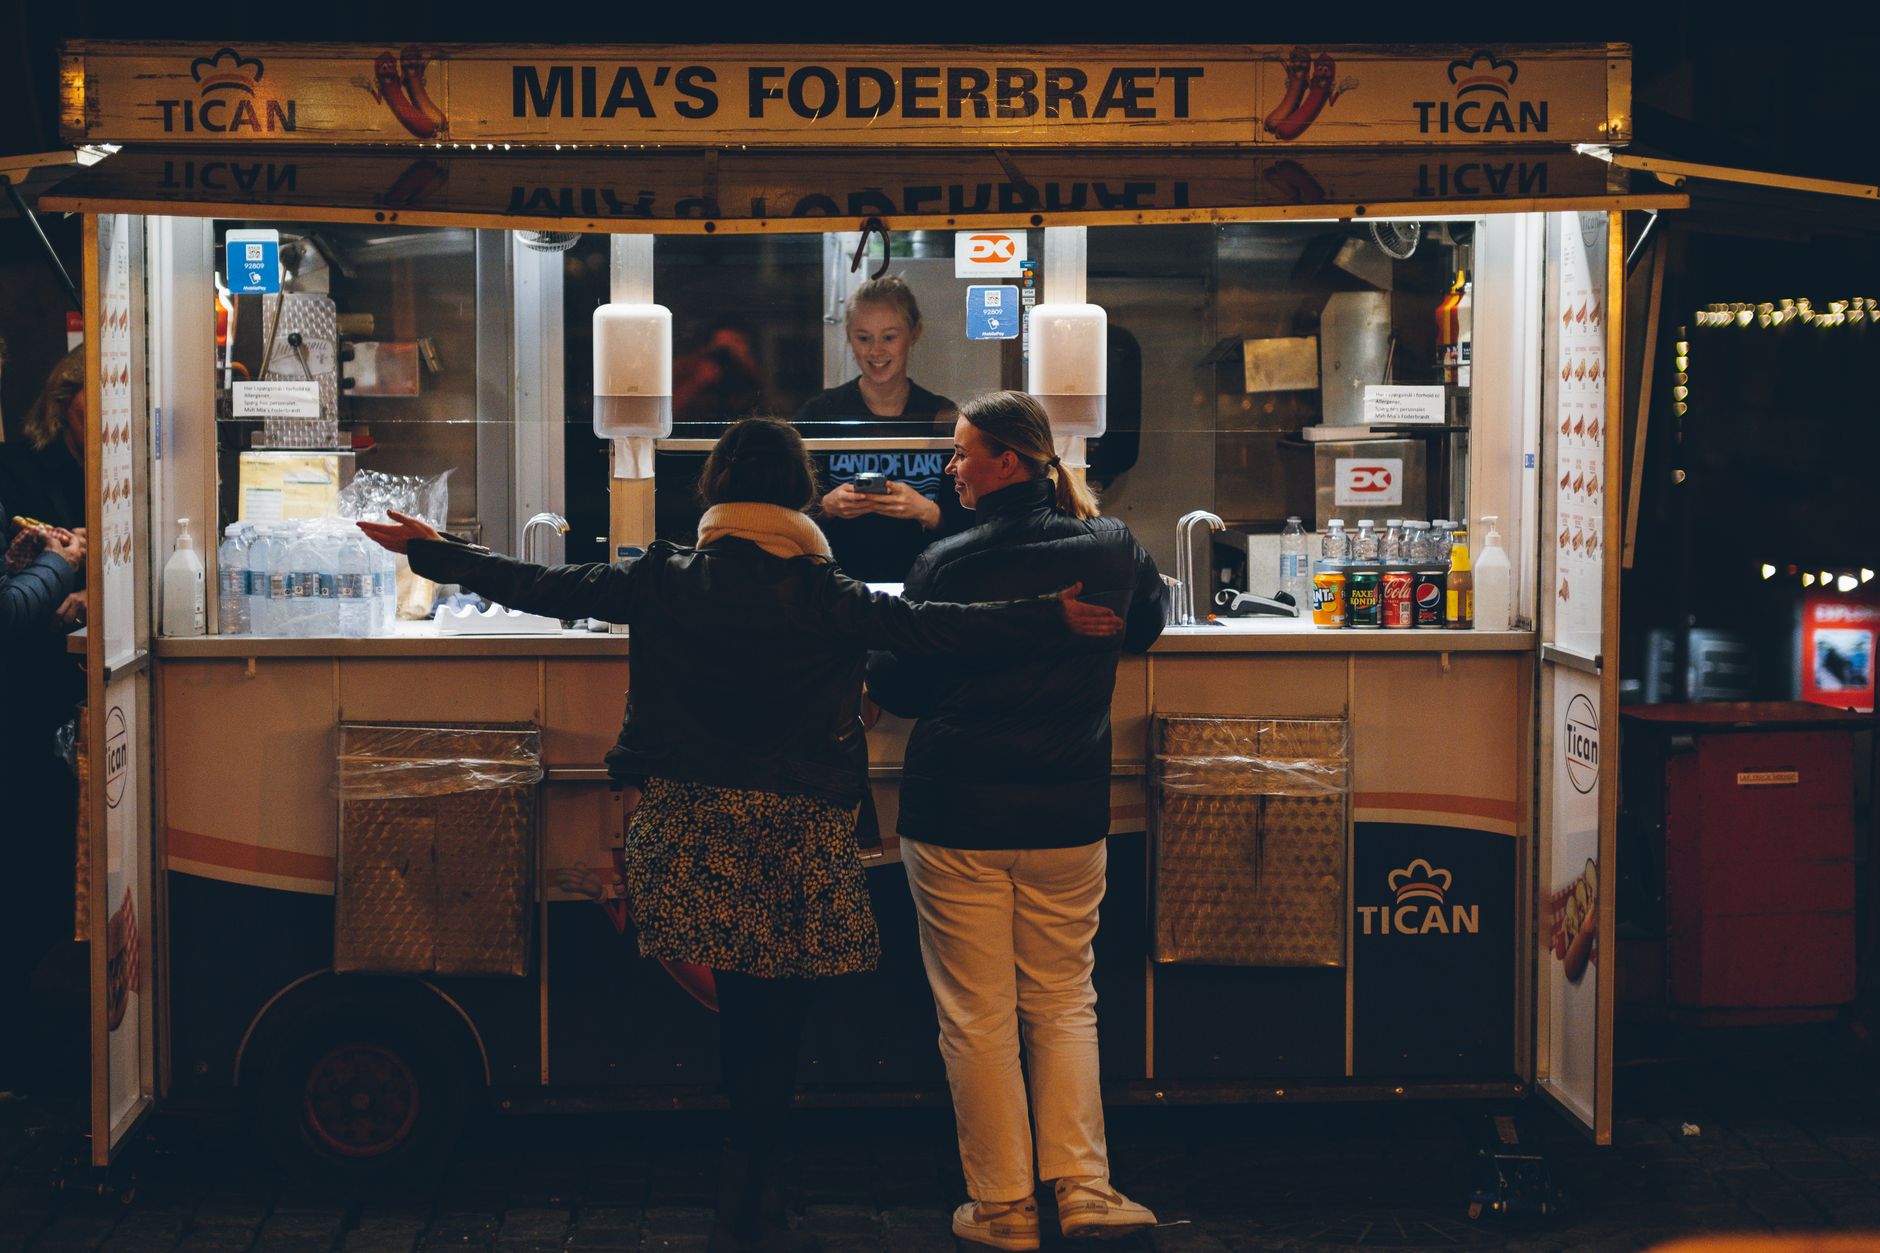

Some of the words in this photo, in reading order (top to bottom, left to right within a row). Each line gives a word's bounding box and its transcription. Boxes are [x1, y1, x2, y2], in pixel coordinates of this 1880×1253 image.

[512, 65, 720, 119] MIA'S
[748, 65, 1204, 119] FODERBRÆT
[156, 99, 297, 132] TICAN
[1413, 101, 1548, 133] TICAN
[105, 743, 126, 776] ican
[1567, 723, 1598, 765] Tican
[1357, 905, 1479, 935] TICAN
